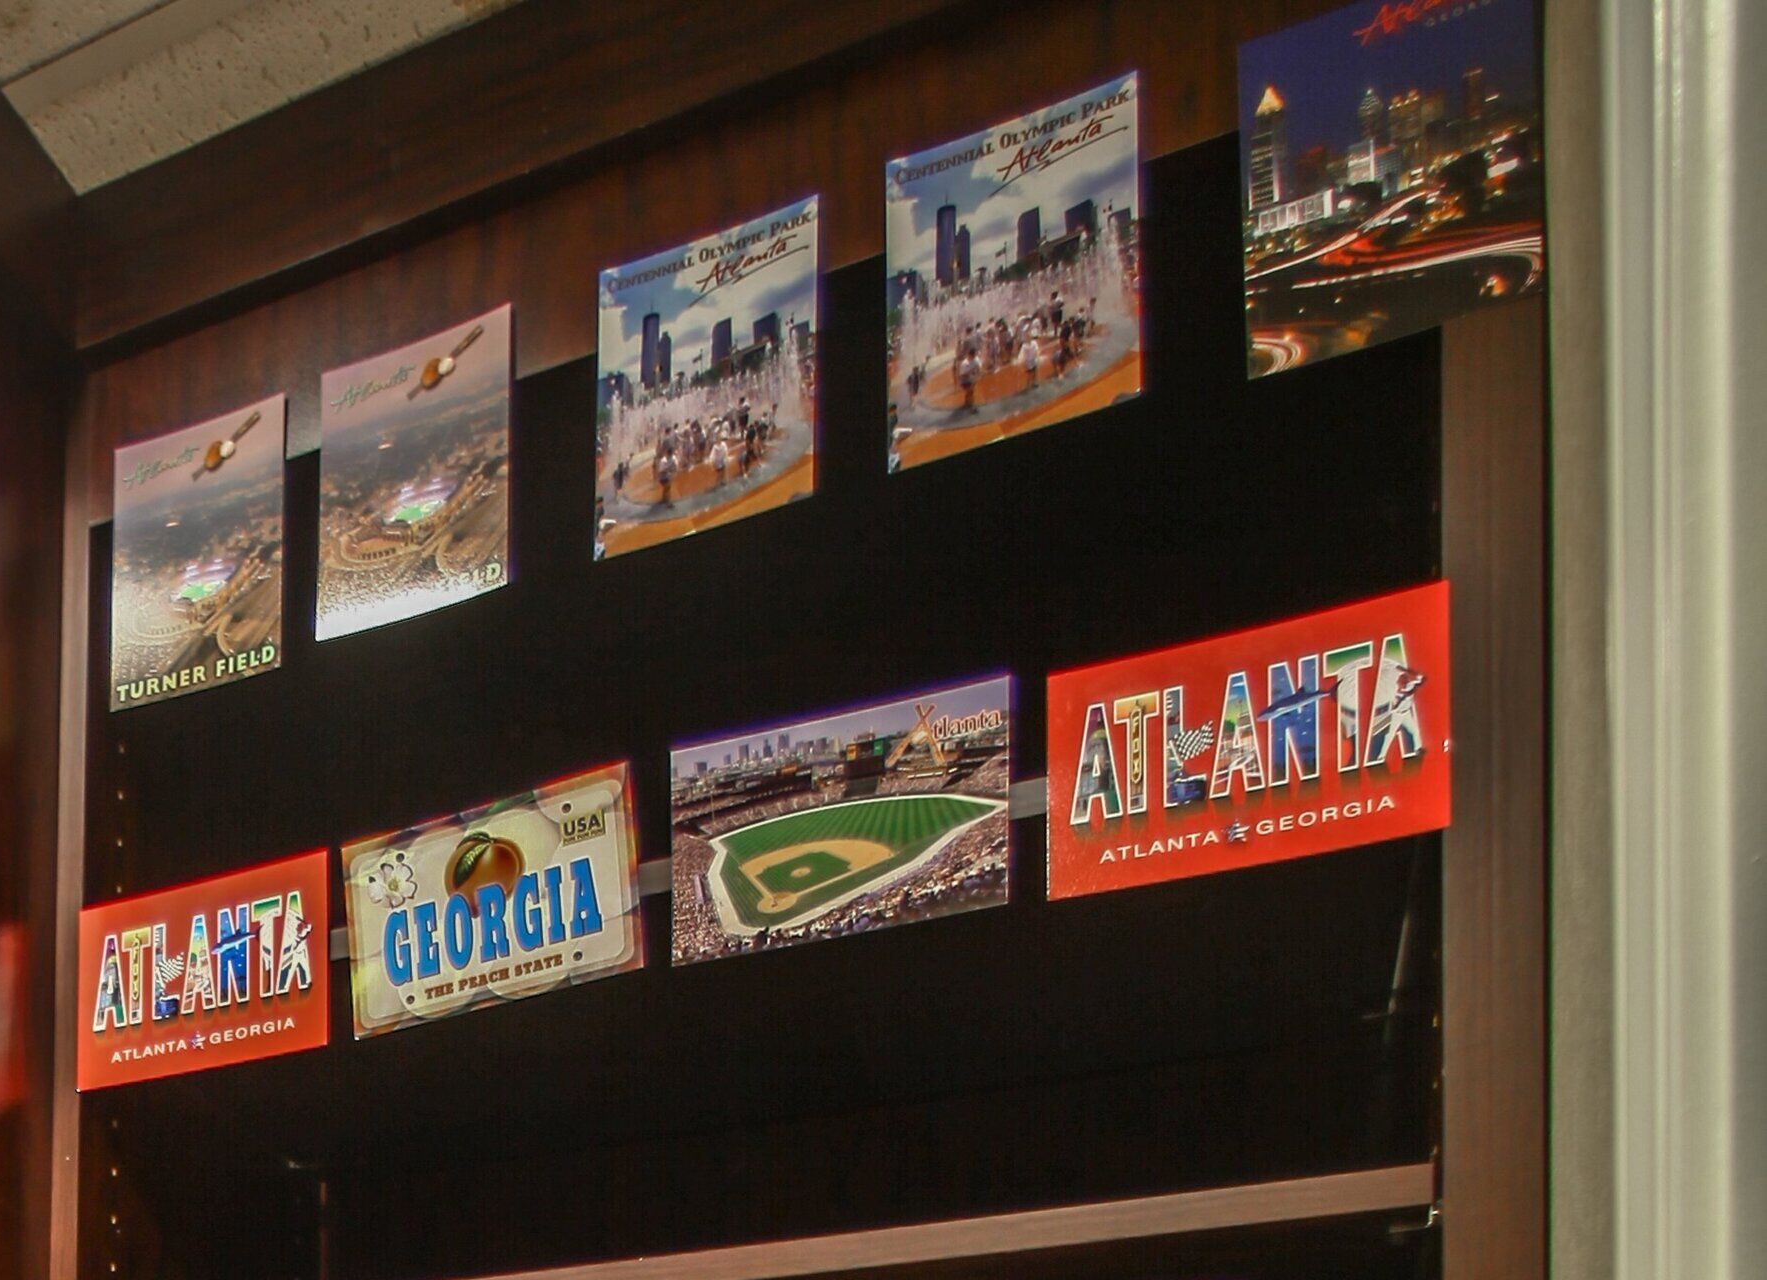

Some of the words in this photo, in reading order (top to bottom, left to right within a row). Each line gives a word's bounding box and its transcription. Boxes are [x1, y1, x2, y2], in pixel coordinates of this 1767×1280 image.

[894, 143, 993, 184] CENTENNIAL
[1001, 110, 1077, 152] OLYMPIC
[1083, 88, 1130, 119] PARK
[998, 115, 1113, 180] Atlanta
[606, 256, 695, 293] CENTENNIAL
[699, 229, 765, 266] OLYMPIC
[770, 210, 811, 235] PARK
[697, 236, 797, 293] Atlanta
[116, 665, 206, 702] TURNER
[216, 645, 276, 677] FIELD
[1069, 633, 1422, 825] ATLANTA
[564, 814, 602, 836] USA
[1100, 831, 1219, 864] ATLANTA
[1256, 795, 1395, 836] GEORGIA
[384, 857, 603, 987] GEORGIA
[93, 890, 312, 1032] ATLANTA
[425, 985, 454, 999] THE
[458, 970, 510, 993] PEACH
[515, 955, 563, 976] STATE
[110, 1040, 187, 1064] ATLANTA
[209, 1016, 295, 1045] GEORGIA
